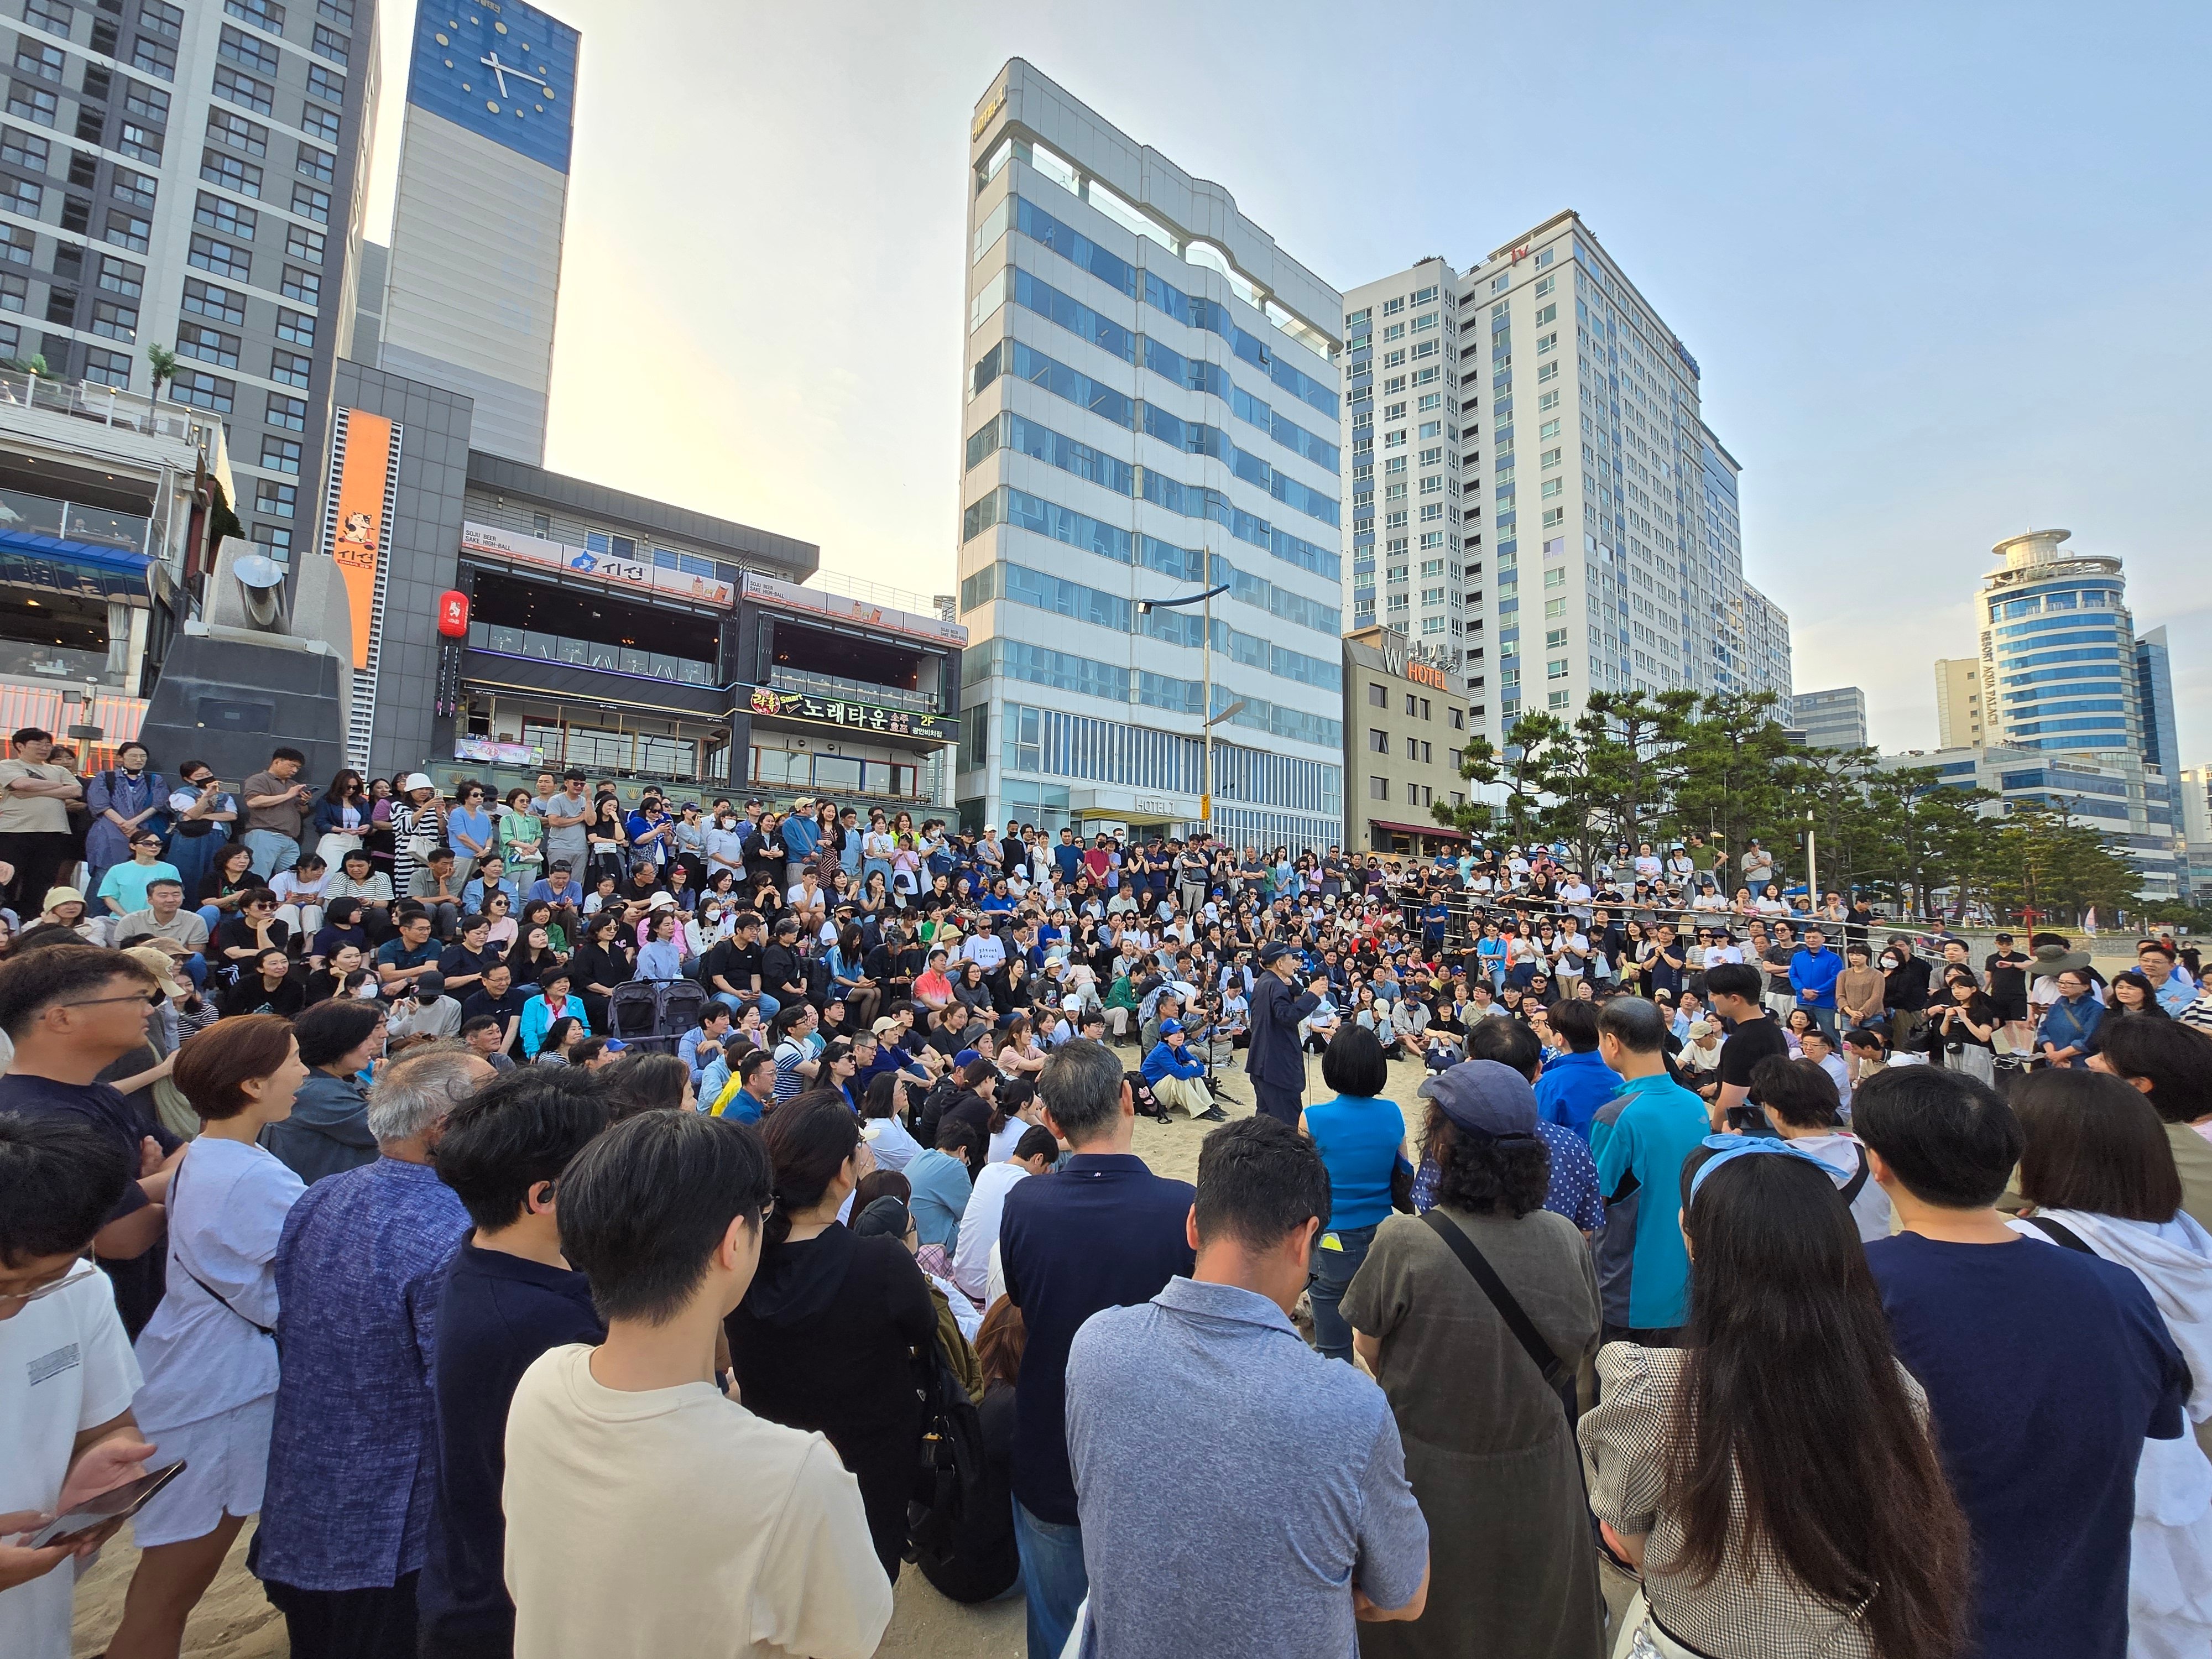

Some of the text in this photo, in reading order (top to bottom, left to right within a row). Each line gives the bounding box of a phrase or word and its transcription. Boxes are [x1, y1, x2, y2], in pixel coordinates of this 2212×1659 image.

[972, 98, 998, 142] HOTEL
[483, 540, 511, 551] HIGH-BALL
[763, 589, 785, 598] HIGH-BALL
[1381, 644, 1448, 691] W HOTEL
[1981, 630, 1999, 727] RESORT AQUA PALACE
[752, 693, 776, 713] 락휴
[780, 693, 804, 703] Smart
[803, 699, 888, 730] 노래타운
[890, 713, 909, 723] 소주
[921, 716, 935, 726] 2F
[890, 722, 909, 733] 호프
[912, 727, 942, 738] 광안비치점
[1136, 800, 1168, 815] HOTEL
